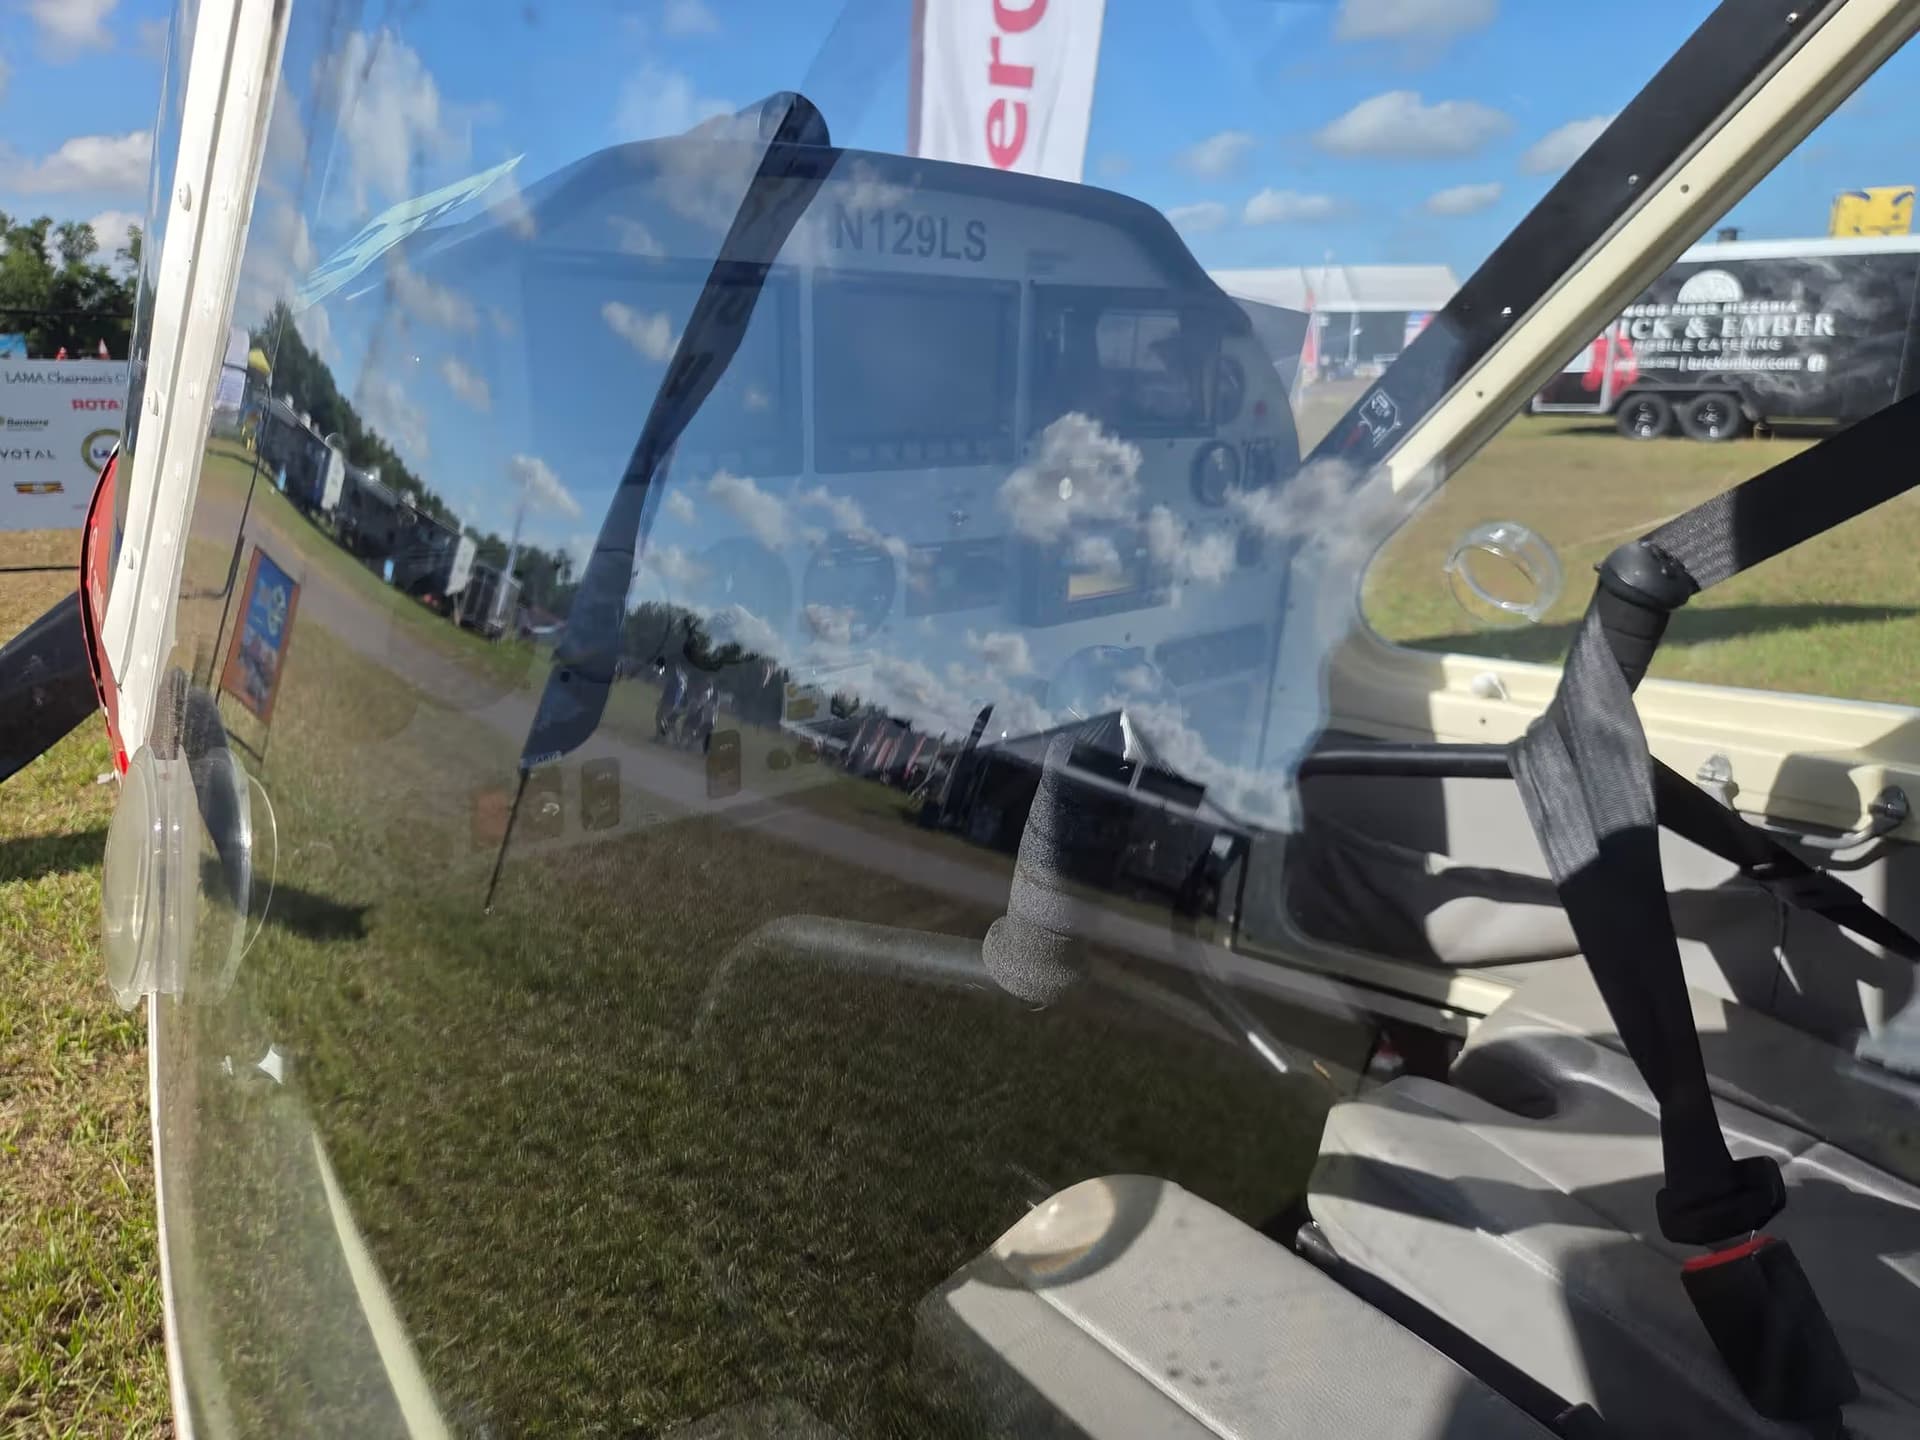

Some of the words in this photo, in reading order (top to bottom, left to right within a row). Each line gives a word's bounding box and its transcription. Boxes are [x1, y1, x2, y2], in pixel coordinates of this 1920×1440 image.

[833, 203, 988, 262] N129LS
[1721, 313, 1836, 338] EMBER
[1697, 338, 1784, 352] CATERING
